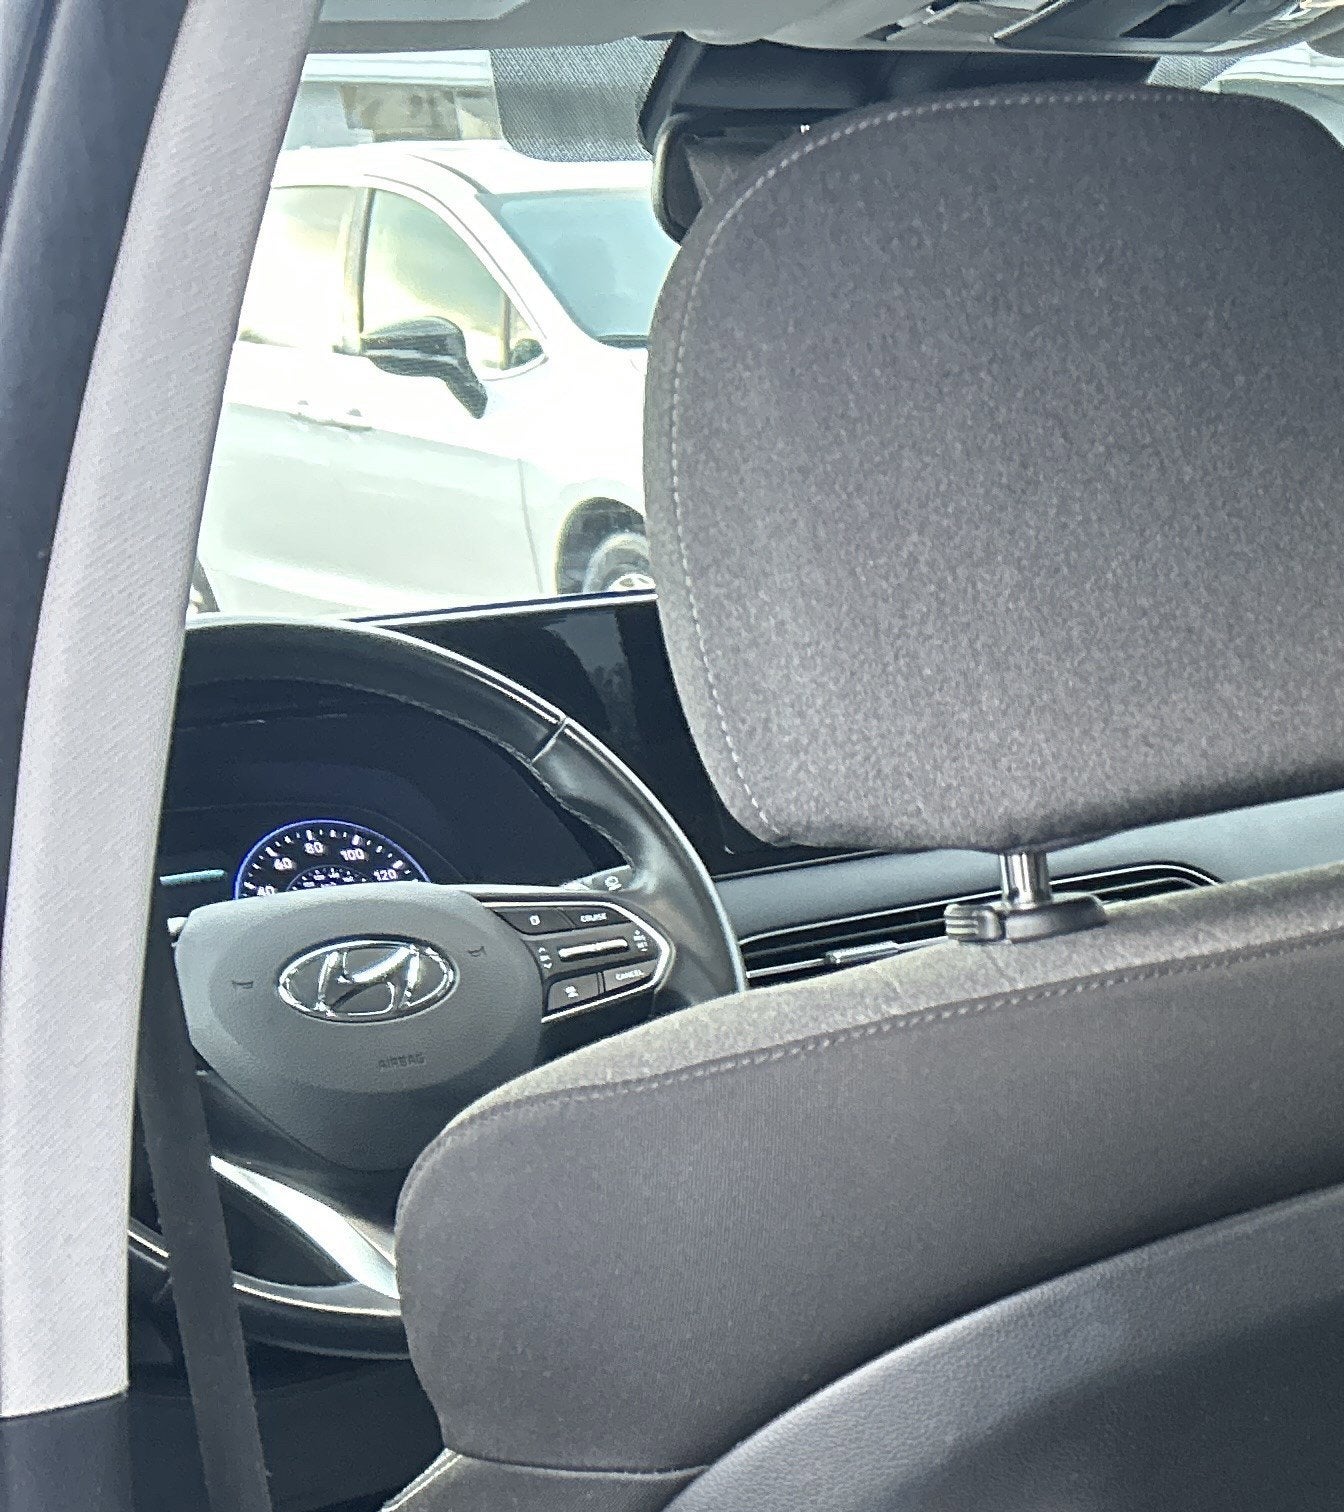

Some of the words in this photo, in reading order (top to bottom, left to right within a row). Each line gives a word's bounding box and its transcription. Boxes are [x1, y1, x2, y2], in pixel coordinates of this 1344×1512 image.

[305, 841, 325, 854] 80
[340, 848, 366, 861] 100
[274, 857, 294, 871] 60
[373, 868, 398, 881] 120
